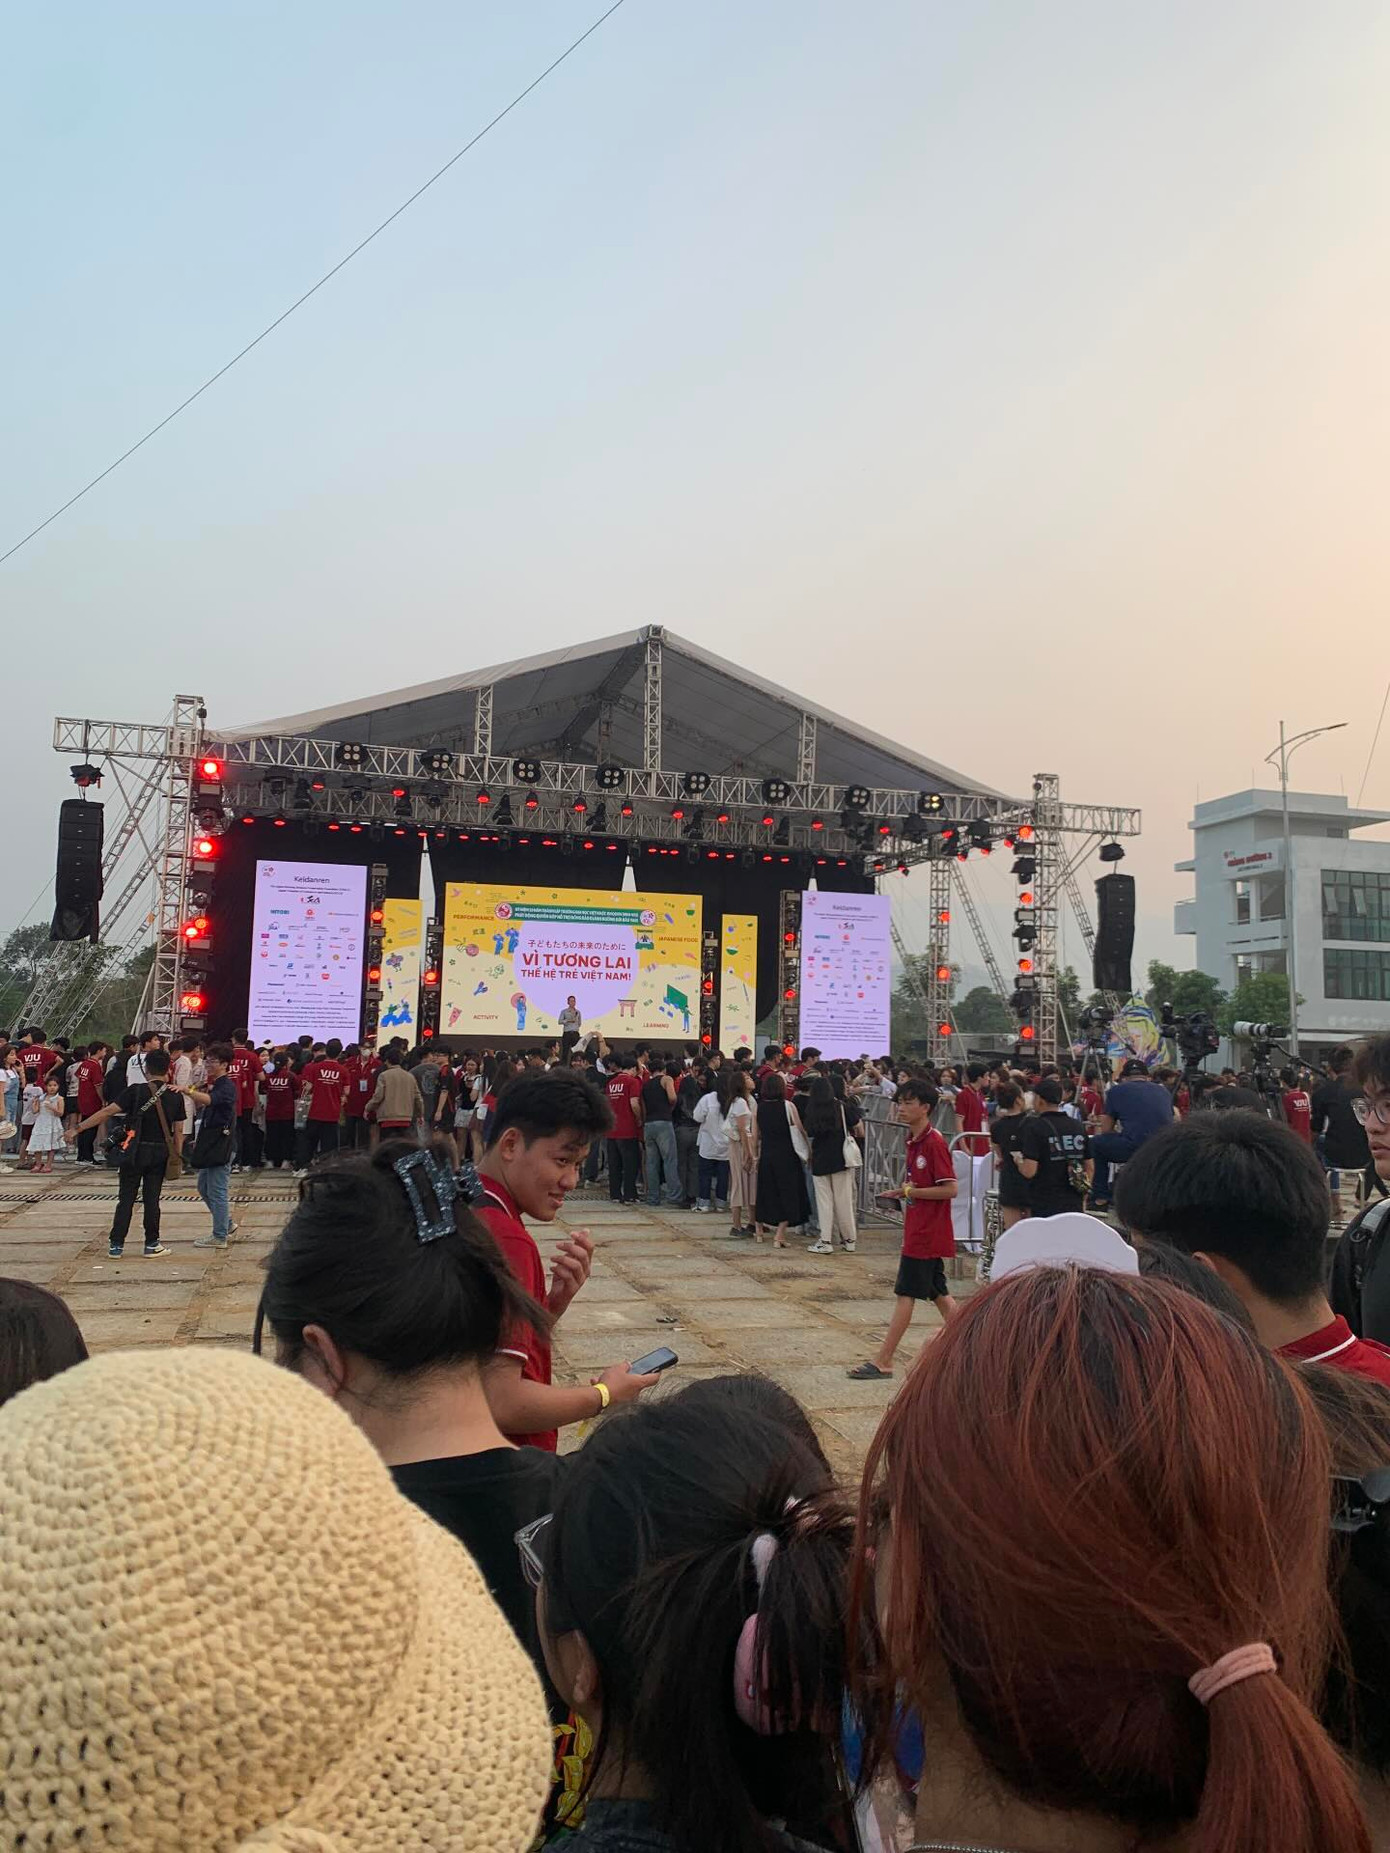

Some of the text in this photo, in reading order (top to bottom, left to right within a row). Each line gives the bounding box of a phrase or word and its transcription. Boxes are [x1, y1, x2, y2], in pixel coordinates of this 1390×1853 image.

[293, 875, 331, 884] Keidanren
[453, 914, 494, 922] PERFORMANCE
[528, 939, 627, 951] 子どもたちの未来のために
[522, 949, 631, 970] VÌ TƯƠNG LAI
[520, 966, 541, 979] THẾ
[543, 968, 557, 981] HỆ
[580, 969, 603, 983] VIỆT
[605, 972, 632, 982] NAM!
[23, 1053, 41, 1063] VJU
[227, 1064, 240, 1073] JU
[320, 1068, 340, 1080] VJU
[269, 1077, 289, 1087] VJU
[609, 1083, 624, 1094] VJU
